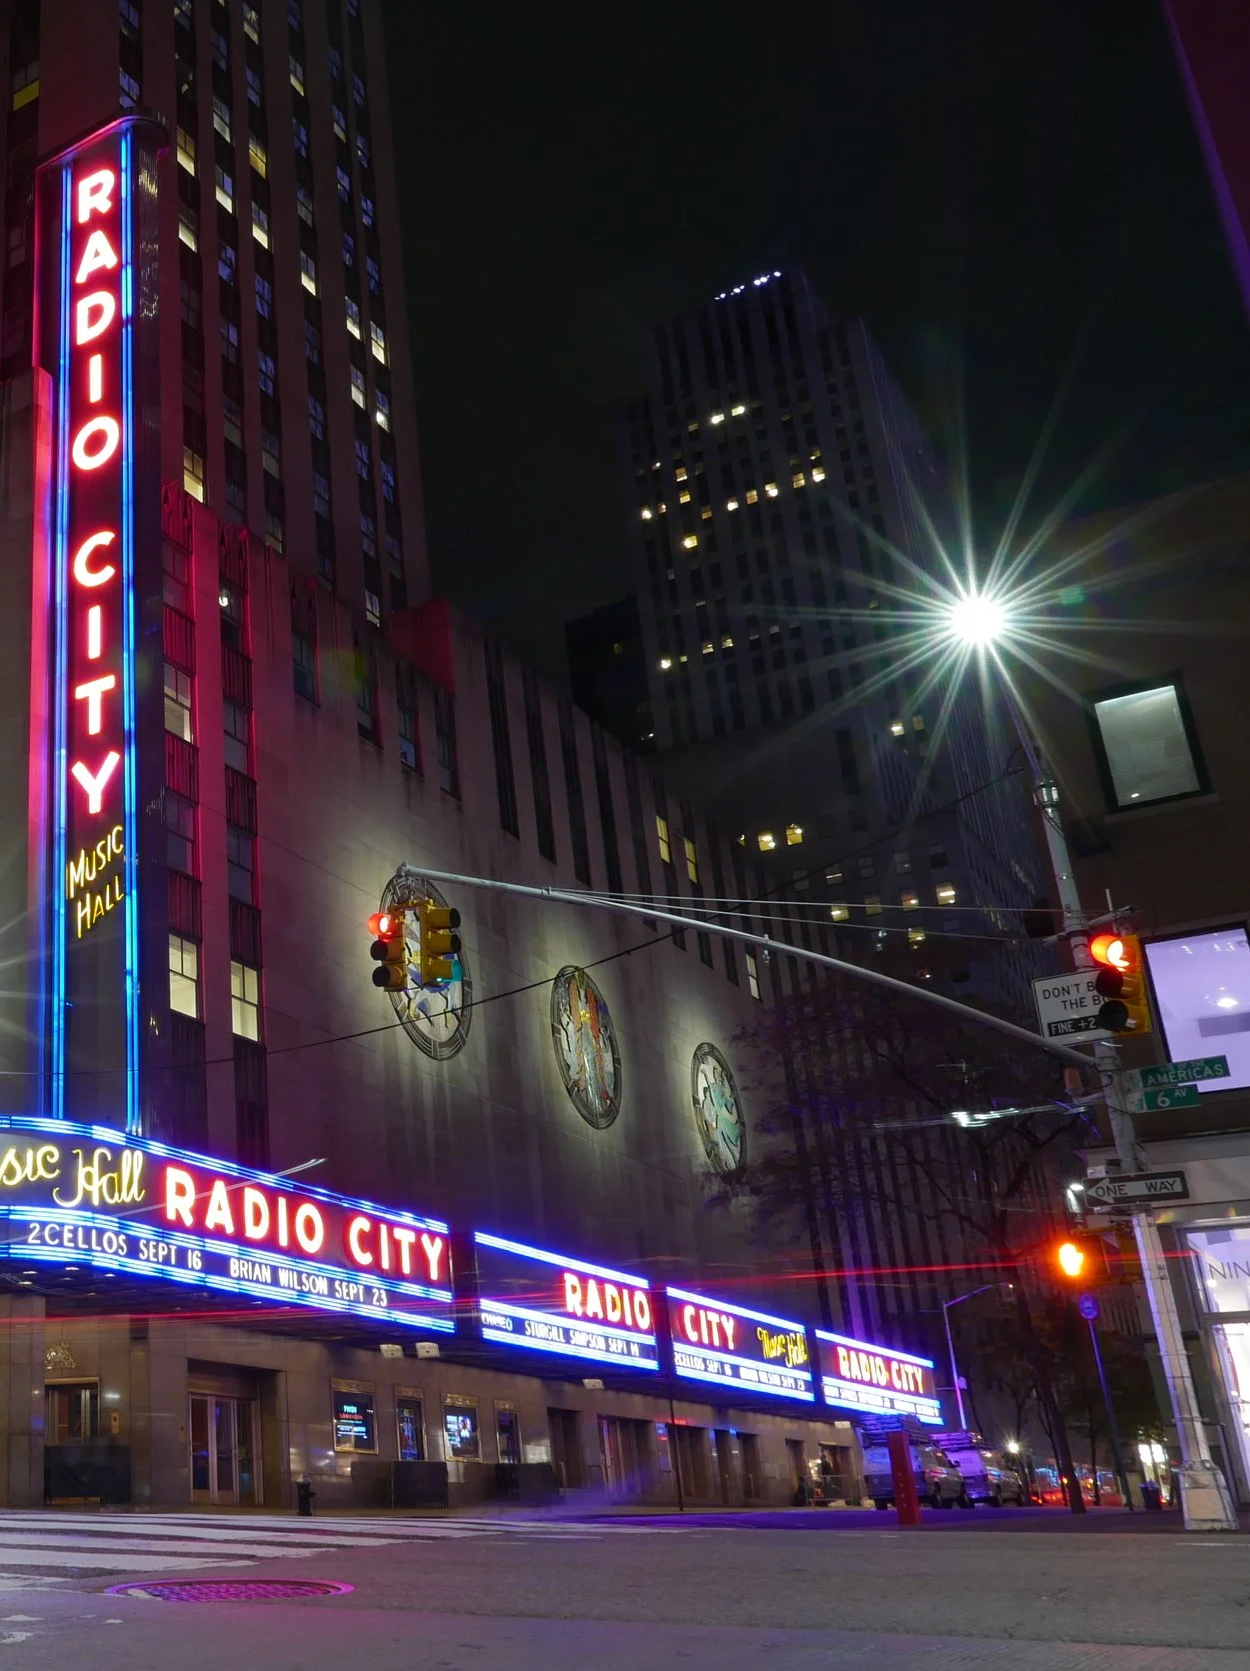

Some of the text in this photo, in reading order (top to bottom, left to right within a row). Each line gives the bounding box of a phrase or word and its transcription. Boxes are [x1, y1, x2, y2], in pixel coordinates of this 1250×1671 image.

[72, 169, 120, 471] RADIO
[71, 531, 120, 815] CITY
[1042, 984, 1081, 1000] DON'T
[1061, 997, 1088, 1010] THE
[1051, 1017, 1097, 1035] FINE +2
[1148, 1064, 1224, 1086] AMERICAS
[1157, 1088, 1187, 1107] 6 AV
[53, 1148, 145, 1208] Hall
[1095, 1179, 1177, 1198] ONE WAY
[27, 1223, 202, 1270] 2CELLOS SEPT 16
[166, 1166, 443, 1281] RADIO CITY
[230, 1257, 388, 1307] BRIAN WILSON SEPT 23
[564, 1273, 650, 1330] RADIO
[683, 1304, 735, 1350] CITY
[837, 1346, 924, 1394] RADIO CITY
